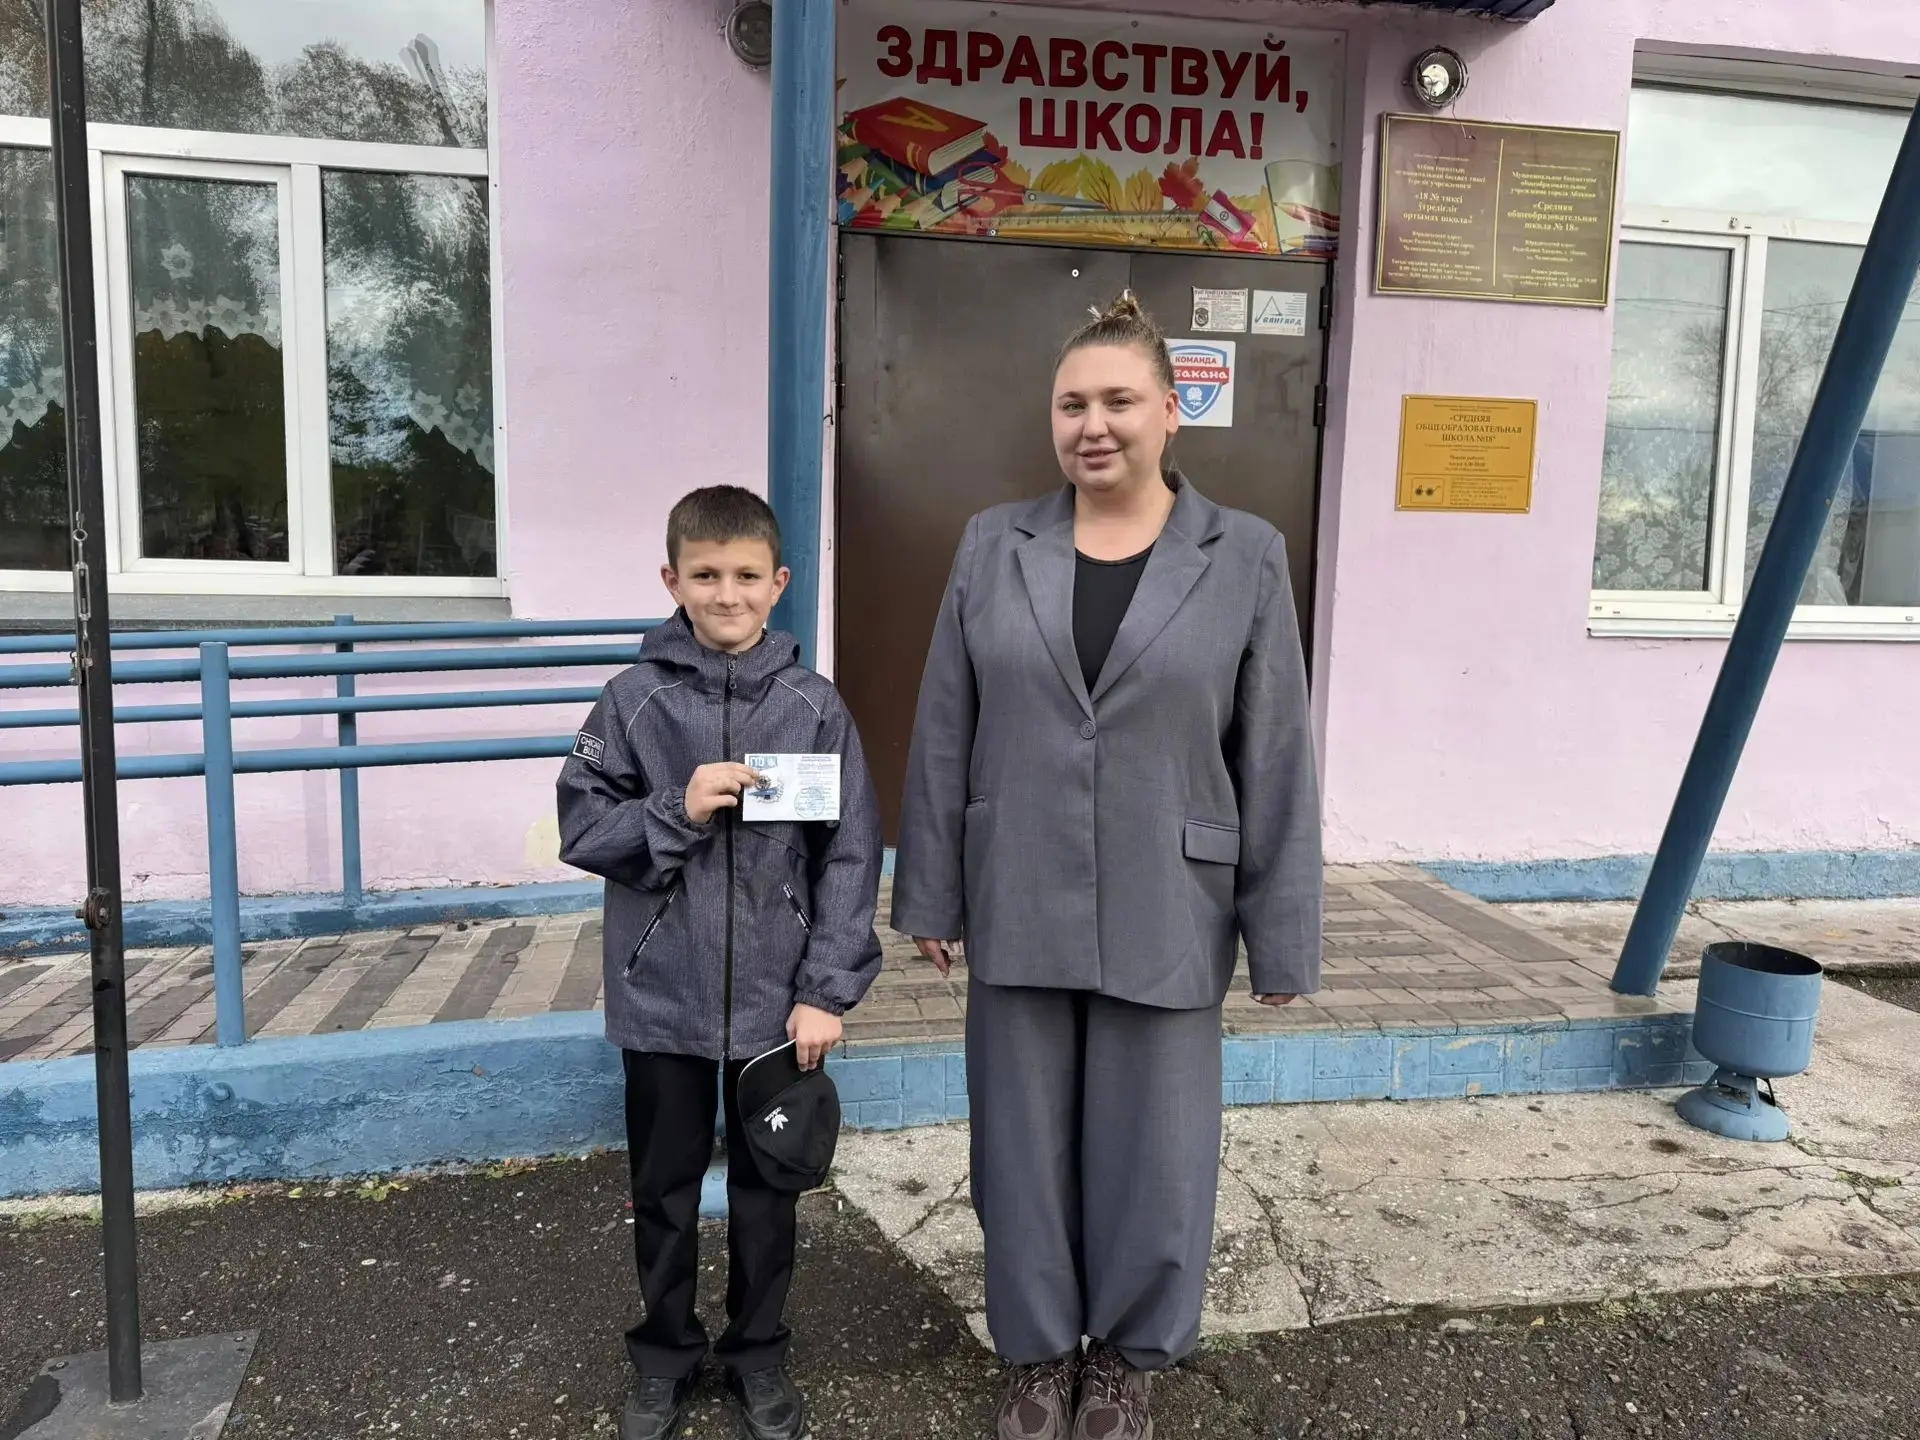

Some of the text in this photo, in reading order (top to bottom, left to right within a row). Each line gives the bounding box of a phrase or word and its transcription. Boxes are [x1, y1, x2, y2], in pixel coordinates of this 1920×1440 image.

[876, 24, 1309, 113] ЗДРАВСТВУЙ,
[1019, 97, 1265, 159] ШКОЛА!
[1175, 355, 1217, 364] КОМАНДА
[1415, 422, 1522, 434] ОБЩЕОБРАЗОВАТЕЛЬНАЯ
[1441, 433, 1475, 442] ШКОЛА
